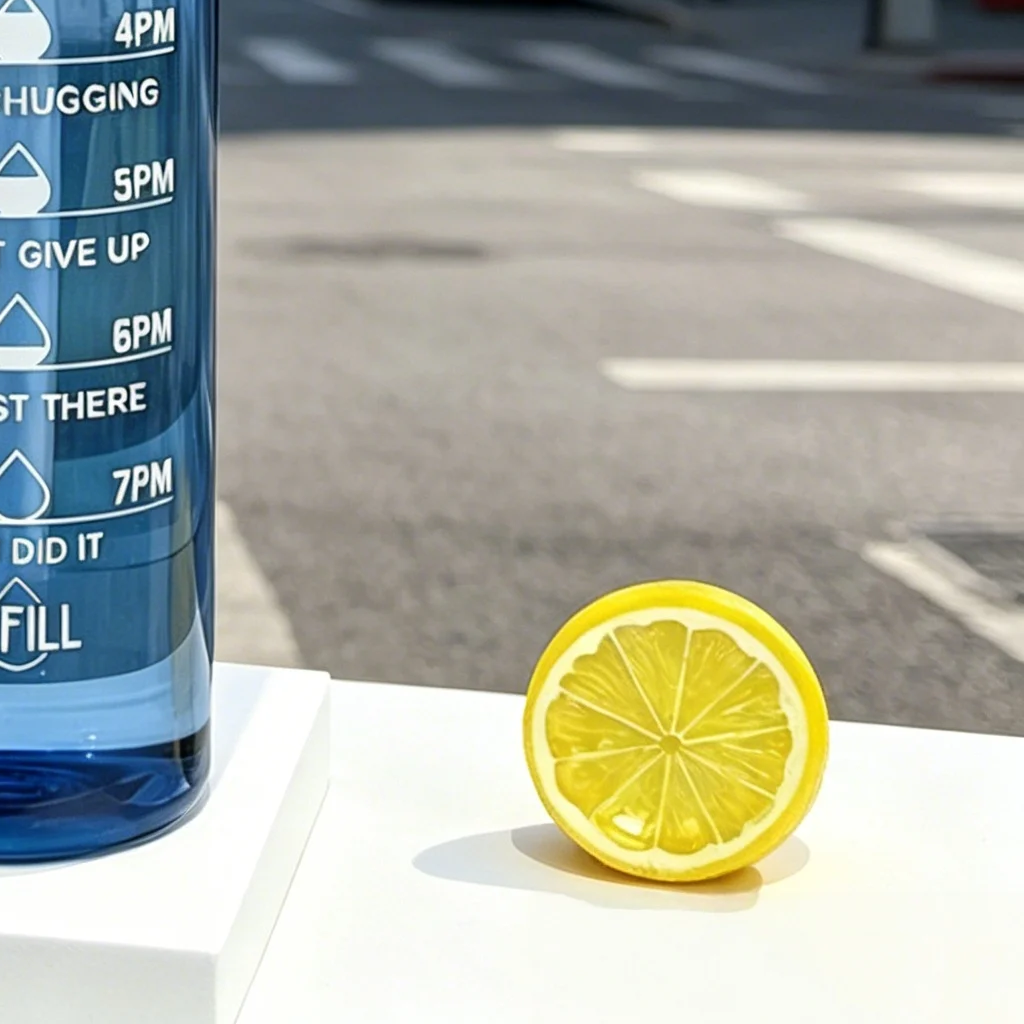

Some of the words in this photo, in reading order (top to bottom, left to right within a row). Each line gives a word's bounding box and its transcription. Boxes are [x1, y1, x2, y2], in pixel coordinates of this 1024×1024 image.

[115, 7, 175, 48] 4PM
[114, 158, 174, 202] 5PM
[19, 238, 96, 269] GIVE
[108, 232, 150, 263] UP
[113, 308, 172, 353] 6PM
[40, 382, 147, 422] THERE
[112, 458, 173, 506] 7PM
[12, 537, 67, 565] DID
[78, 532, 104, 561] IT
